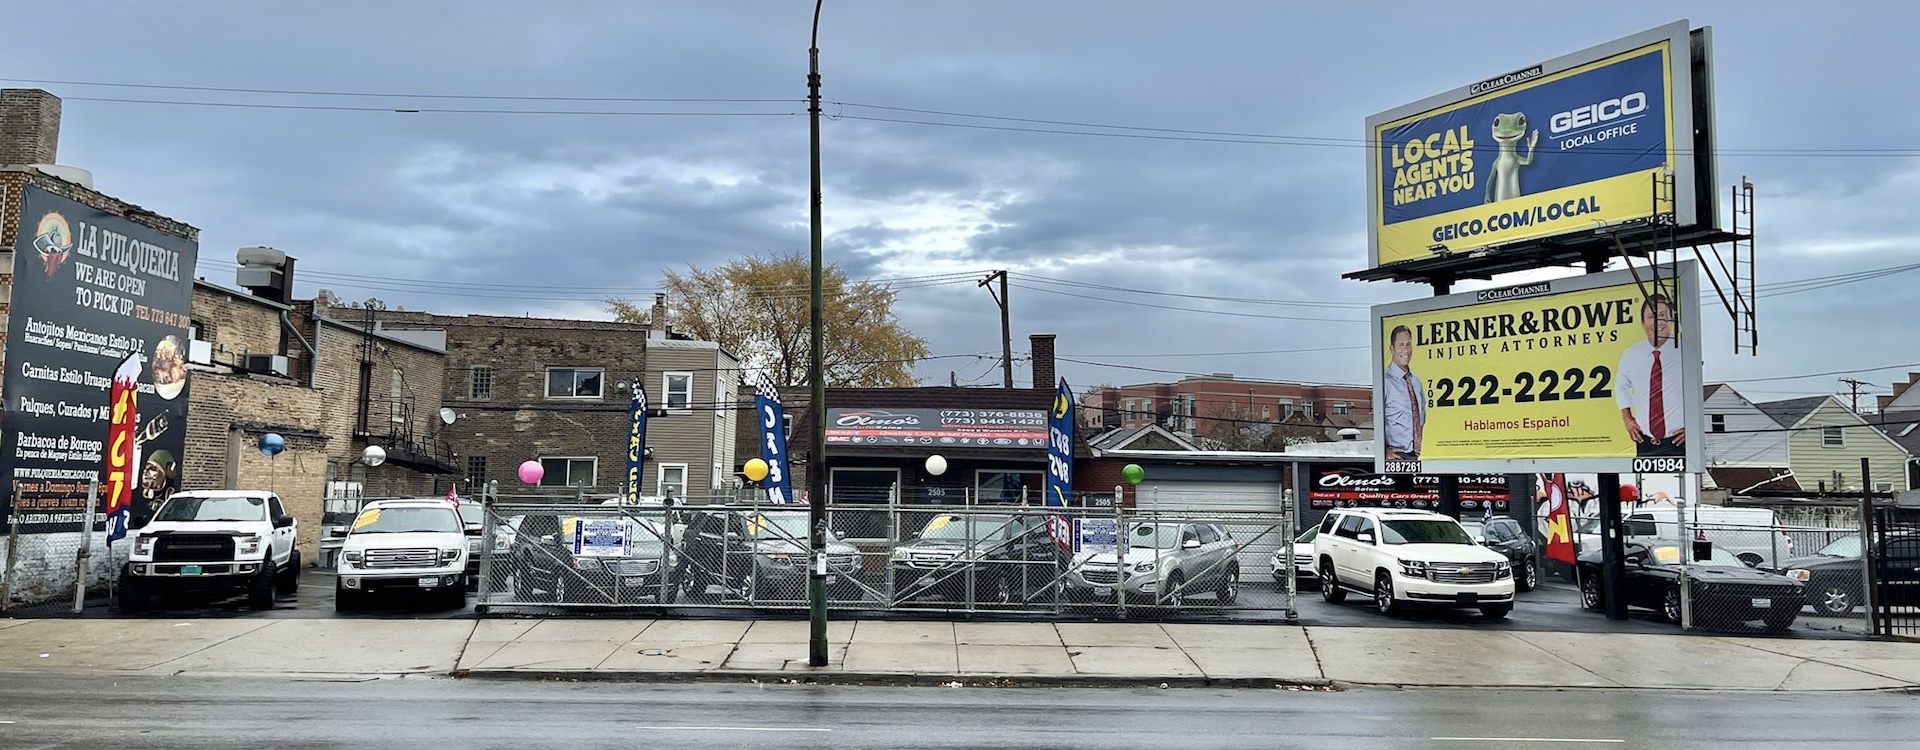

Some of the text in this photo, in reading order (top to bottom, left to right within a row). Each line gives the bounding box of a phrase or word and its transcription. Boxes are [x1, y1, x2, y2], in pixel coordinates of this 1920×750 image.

[1550, 92, 1646, 133] GEICO
[1392, 125, 1474, 168] LOCAL
[1561, 123, 1637, 150] LOCAL OFFICE
[1394, 151, 1474, 189] AGENTS
[1394, 172, 1474, 206] NEAR YOU
[1433, 196, 1600, 242] GEICO.COM/LOCAL
[77, 221, 179, 281] LA PULQUERIA
[75, 262, 146, 297] WE ARE OPEN
[76, 287, 134, 317] TO PICK UP
[135, 305, 150, 321] TEL
[151, 308, 164, 324] 773
[165, 312, 178, 327] 647
[25, 317, 147, 353] Antojitos Mexicanos Estilo D.F.
[1416, 300, 1633, 346] LERNER&ROWE
[1428, 328, 1618, 360] INJURY ATTORNEYS
[22, 362, 59, 381] Carnitas
[60, 367, 82, 385] Estilo
[84, 371, 112, 391] Uruapa
[1436, 365, 1613, 407] 222-2222
[20, 397, 55, 417] Pulques,
[57, 402, 91, 418] Curados
[92, 408, 99, 422] y
[836, 415, 920, 426] Olmo's
[940, 410, 975, 418] (773)
[1464, 415, 1571, 432] Hablamos Español
[17, 431, 102, 455] Barbacoa de Borrego
[1319, 474, 1395, 486] Olmo's
[1385, 462, 1421, 472] 2887261
[1634, 459, 1686, 473] 001984
[37, 495, 60, 509] jueves
[46, 481, 75, 495] Domingo
[928, 488, 946, 496] 2505
